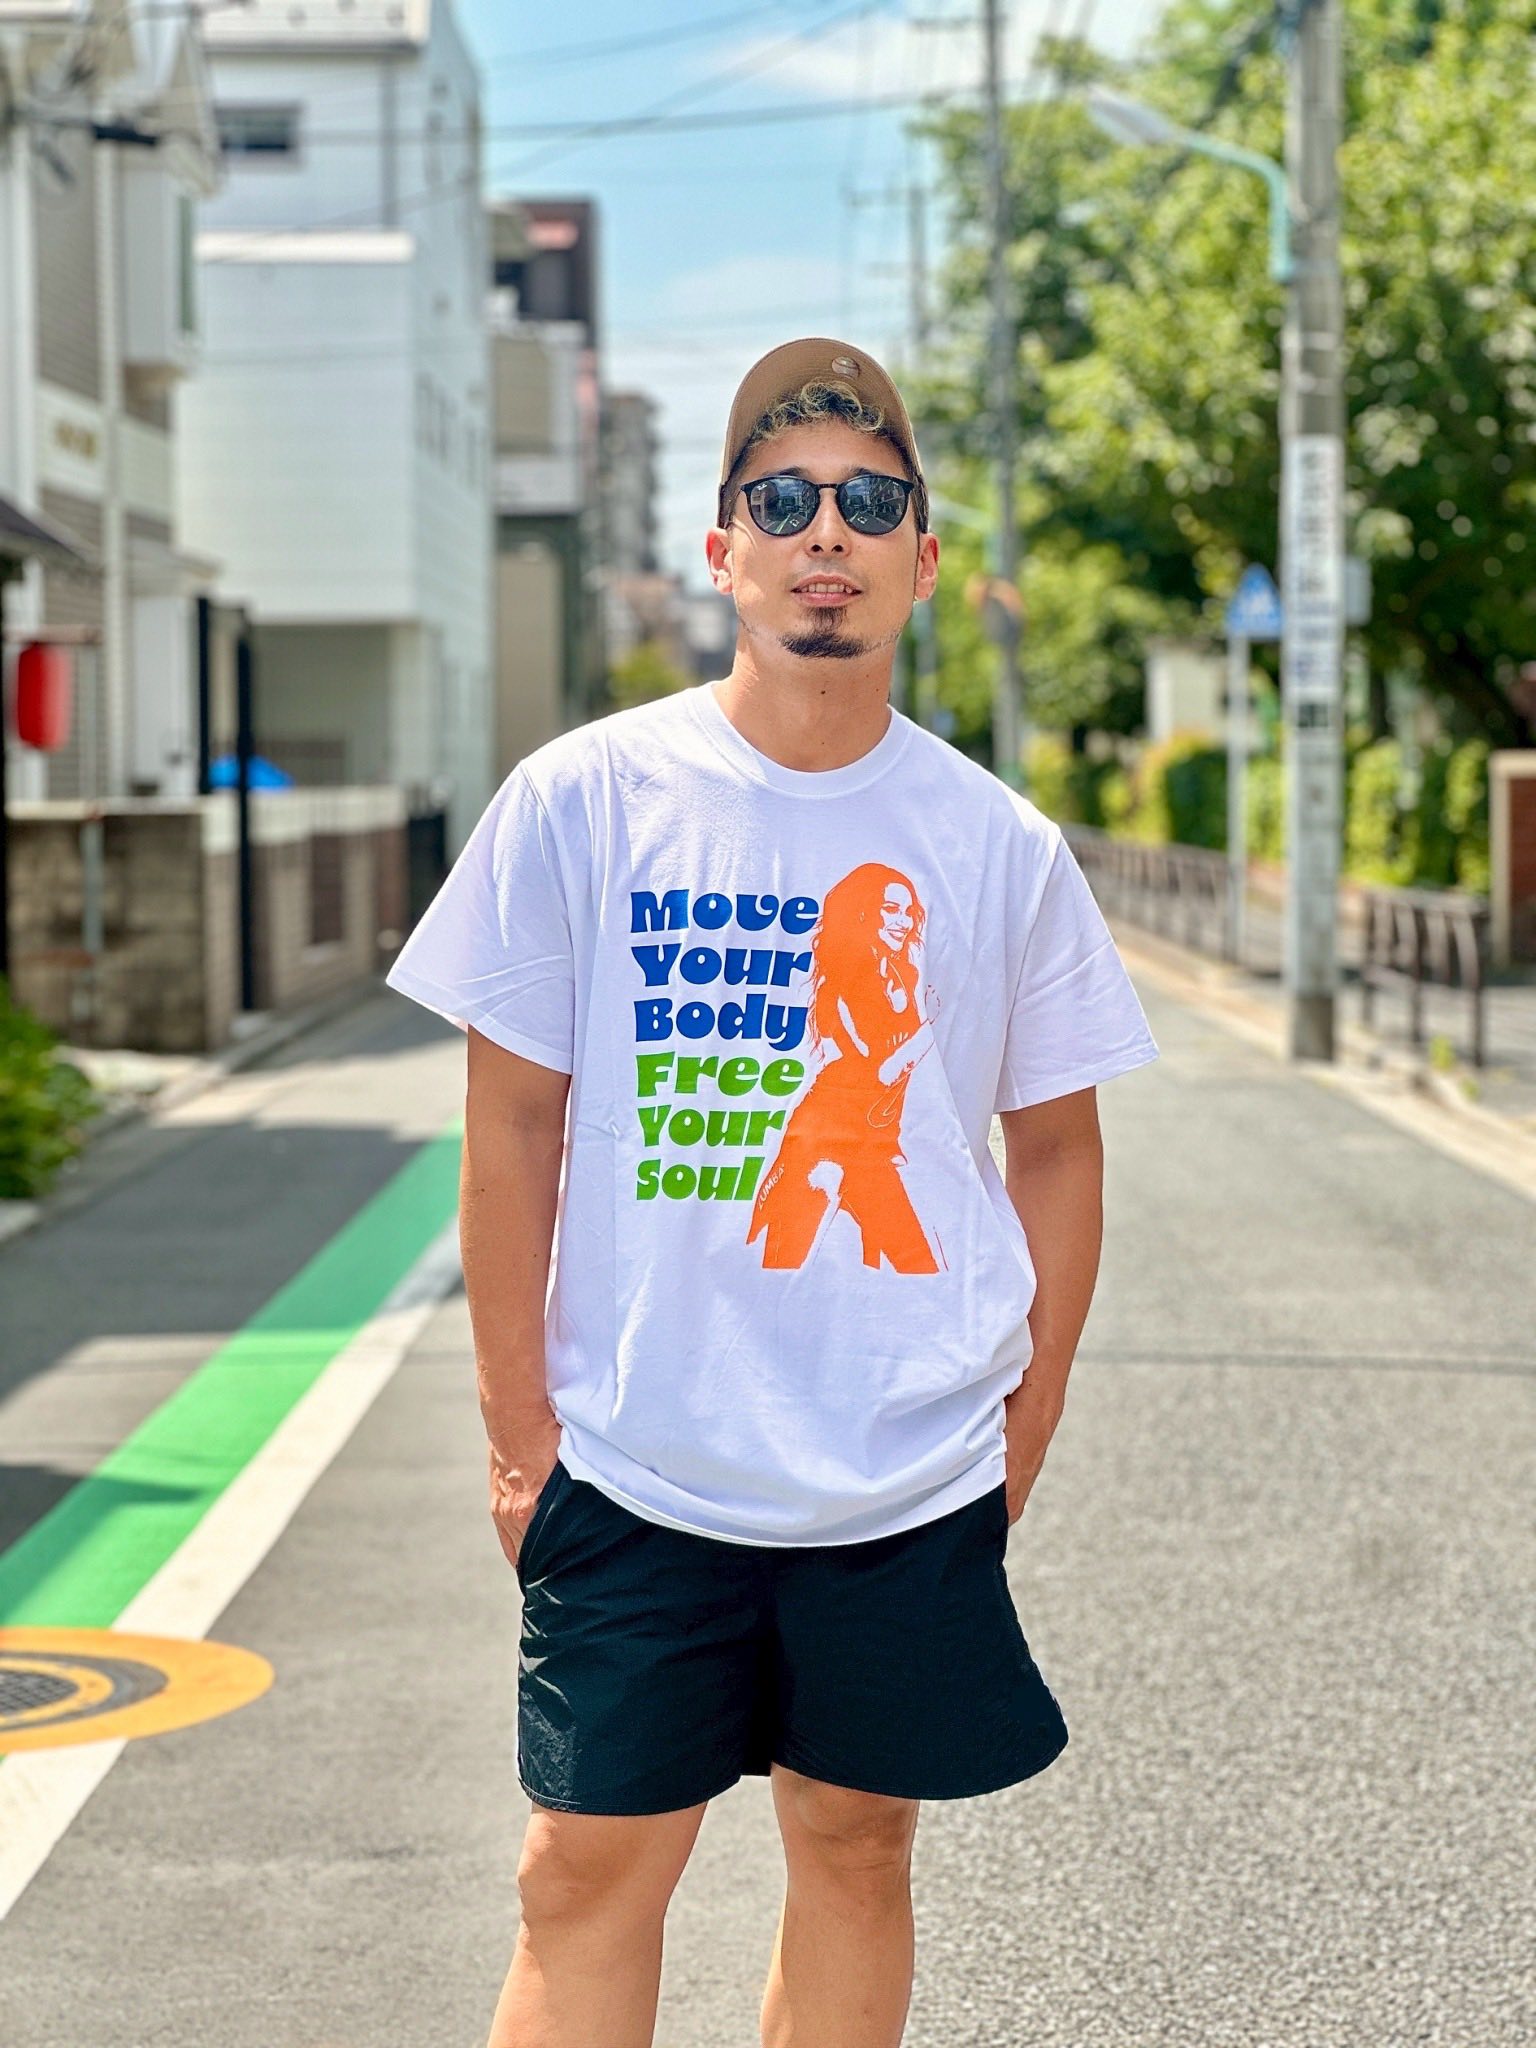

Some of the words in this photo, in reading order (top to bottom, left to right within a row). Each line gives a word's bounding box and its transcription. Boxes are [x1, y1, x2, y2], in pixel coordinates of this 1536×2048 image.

[630, 889, 819, 934] Move
[631, 943, 813, 987] Your
[633, 993, 808, 1052] Body
[636, 1052, 804, 1097] Free
[638, 1105, 787, 1147] Your
